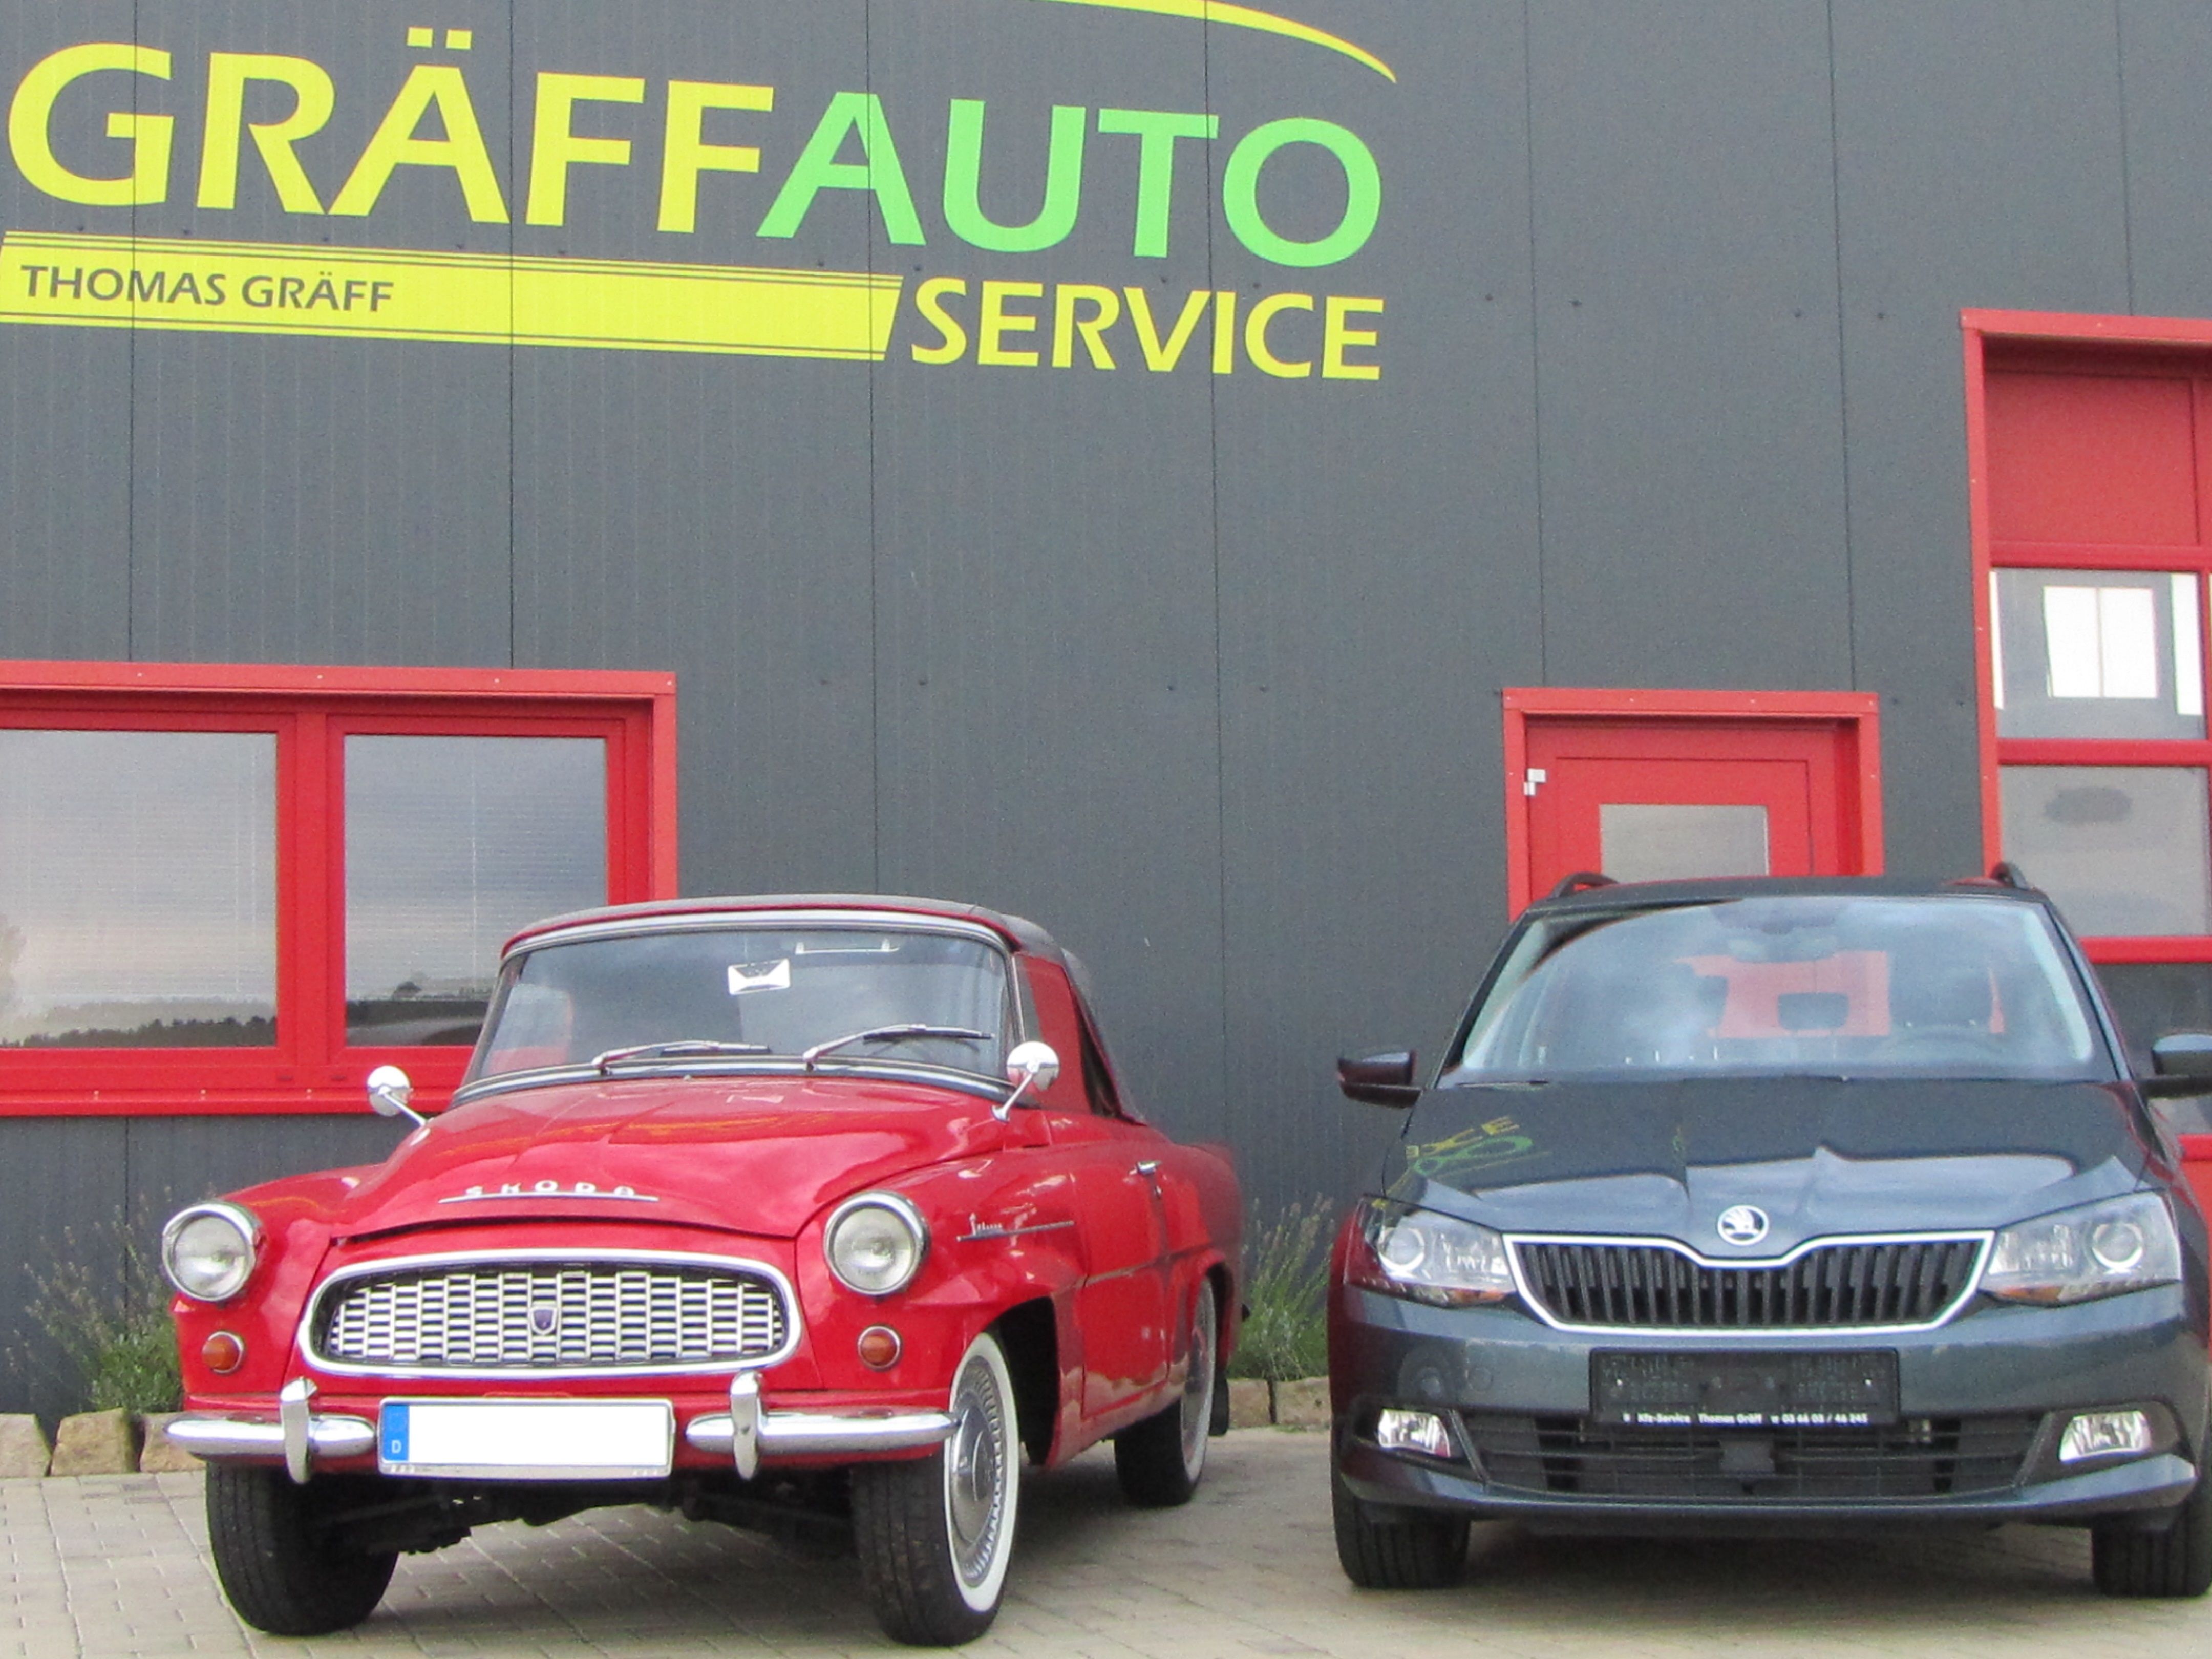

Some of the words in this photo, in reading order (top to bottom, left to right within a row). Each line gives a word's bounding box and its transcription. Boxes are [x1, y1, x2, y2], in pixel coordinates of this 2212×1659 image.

[20, 265, 226, 306] THOMAS
[242, 271, 394, 312] GRÄFF
[911, 276, 1384, 381] SERVICE
[391, 1440, 401, 1453] D
